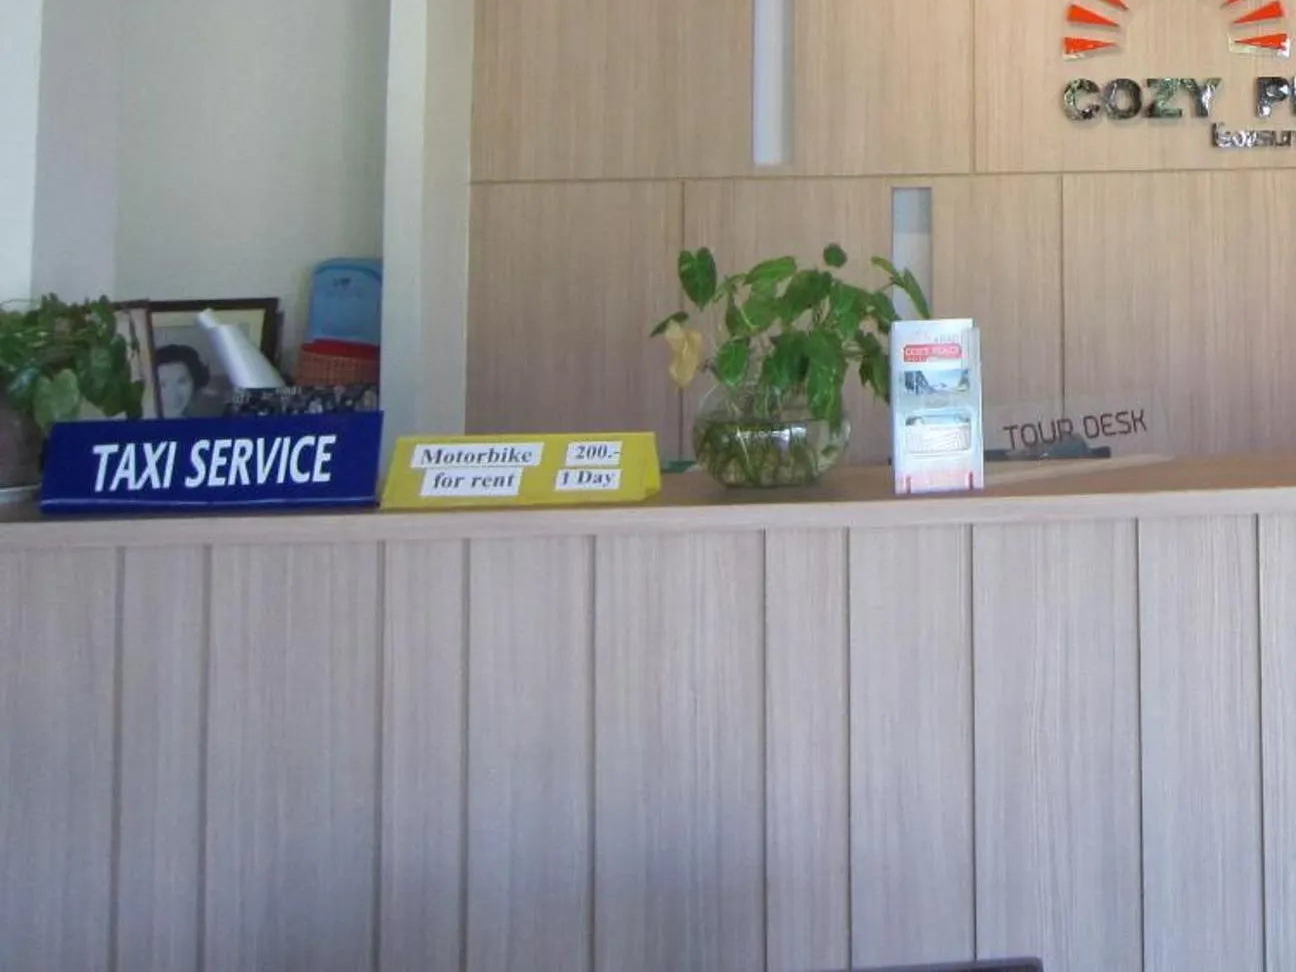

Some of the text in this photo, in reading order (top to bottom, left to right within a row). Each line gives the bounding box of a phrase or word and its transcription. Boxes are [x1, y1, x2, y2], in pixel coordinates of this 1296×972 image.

[1063, 77, 1221, 120] COZY
[1003, 409, 1147, 449] TOUR DESK
[92, 434, 337, 492] TAXI SERVICE
[420, 447, 533, 465] Motorbike
[432, 471, 515, 489] for rent
[578, 469, 615, 488] Day
